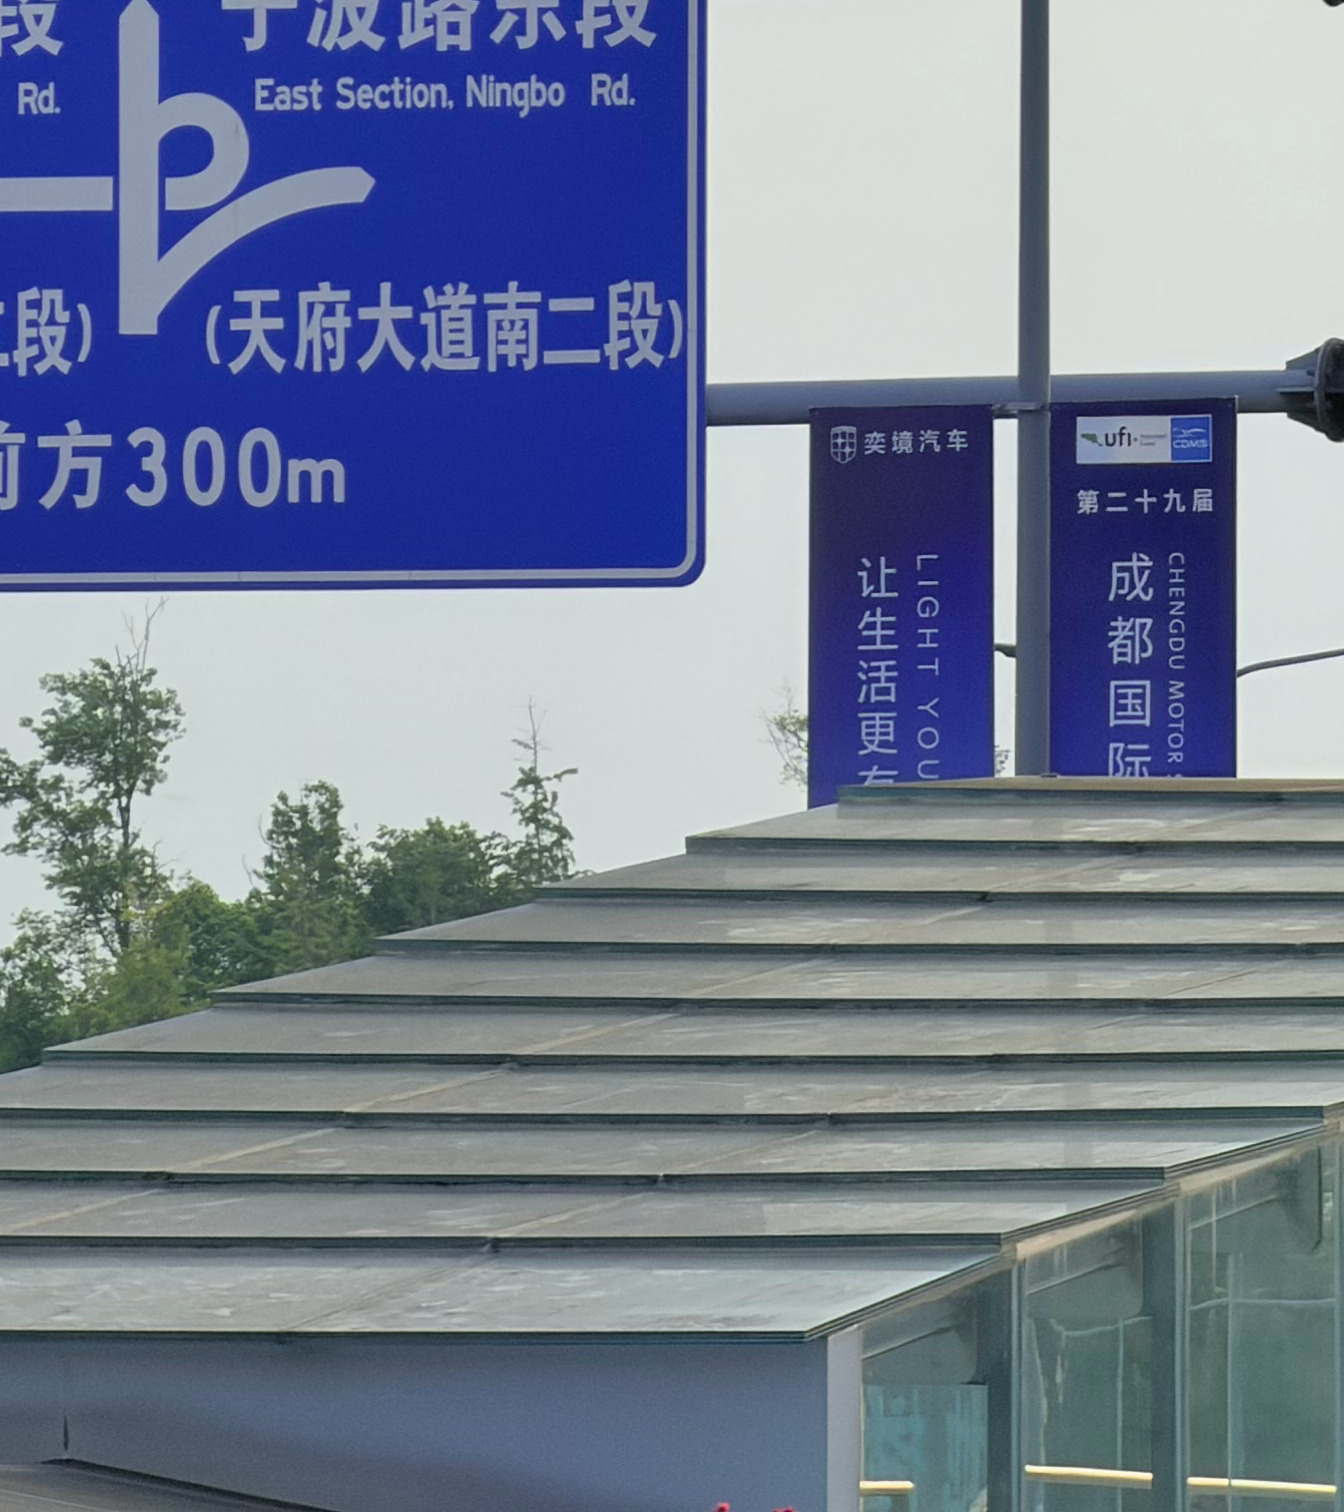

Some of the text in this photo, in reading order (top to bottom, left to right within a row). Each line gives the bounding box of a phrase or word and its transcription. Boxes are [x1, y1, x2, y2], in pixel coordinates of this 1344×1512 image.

[17, 82, 61, 115] Rd.
[255, 78, 323, 111] East
[466, 74, 566, 118] Ningbo
[591, 73, 636, 107] Rd.
[206, 280, 683, 375] (天府大道南二段)
[864, 429, 968, 455] 奕境汽车
[1077, 488, 1213, 515] 第二十九届
[917, 554, 940, 676] LIGHT
[1168, 552, 1185, 670] CHENGDU
[1107, 552, 1154, 777] 成都国际
[1167, 680, 1185, 763] MOTOR
